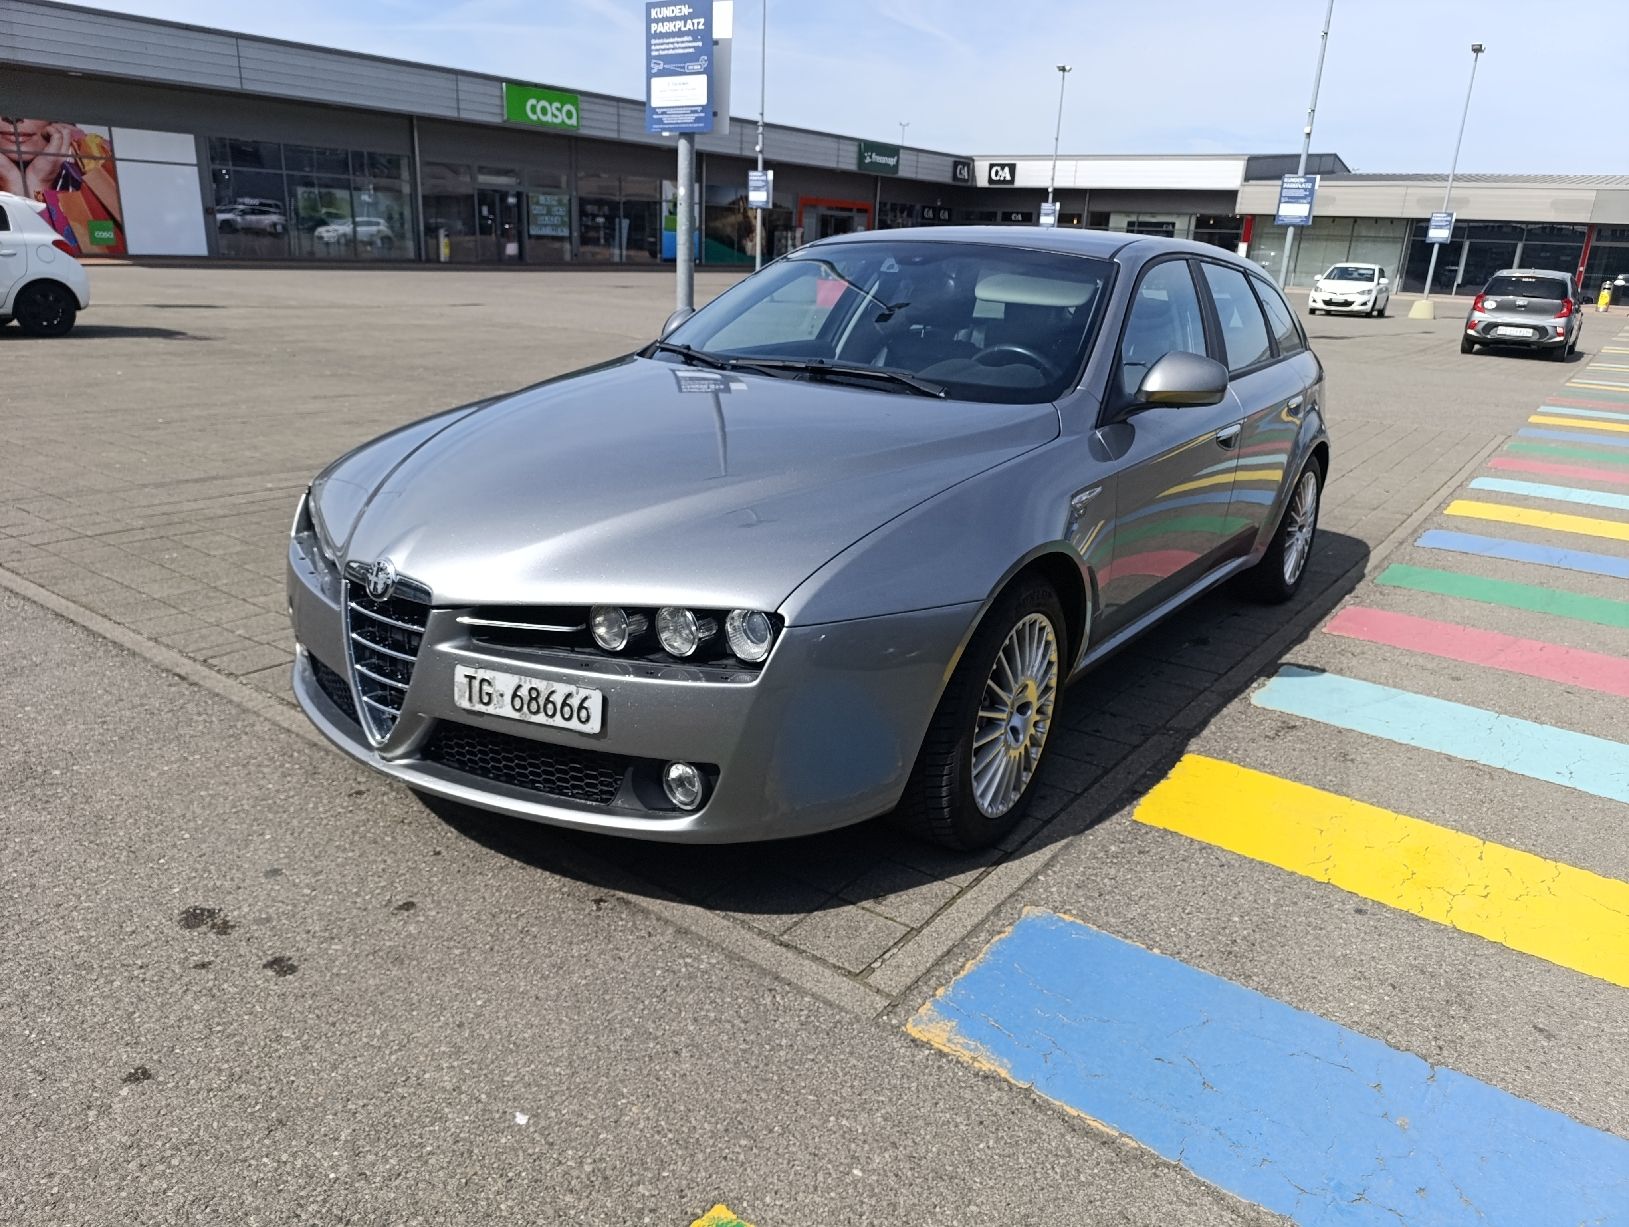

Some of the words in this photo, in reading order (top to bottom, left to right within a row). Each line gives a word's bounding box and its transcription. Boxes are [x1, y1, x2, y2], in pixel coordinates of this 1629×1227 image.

[651, 4, 693, 19] KUNDEN-
[651, 18, 705, 34] PARKPLATZ
[526, 98, 578, 126] casa
[464, 674, 492, 706] TG
[510, 683, 592, 725] 68666
